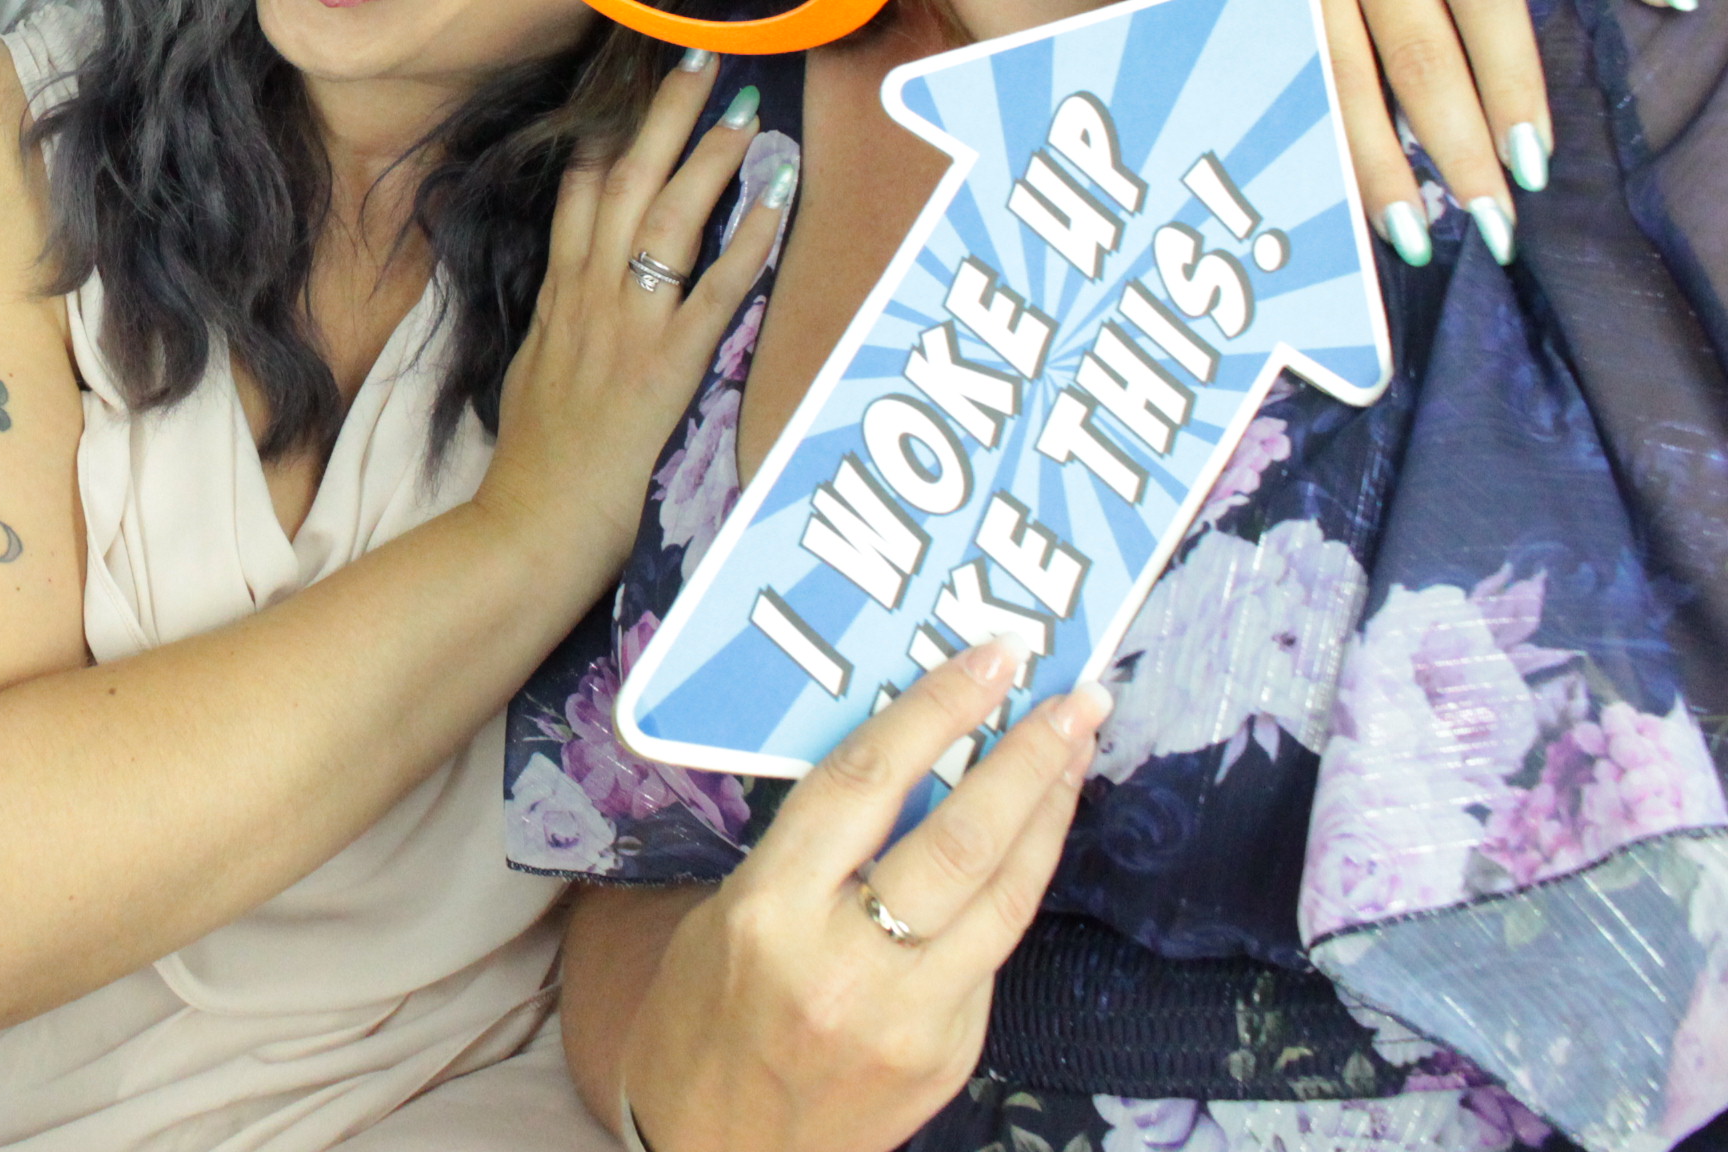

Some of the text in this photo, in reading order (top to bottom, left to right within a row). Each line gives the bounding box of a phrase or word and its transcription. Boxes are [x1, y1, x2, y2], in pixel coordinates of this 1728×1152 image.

[749, 90, 1148, 699] I WOKE UP
[1035, 149, 1290, 508] THIS!
